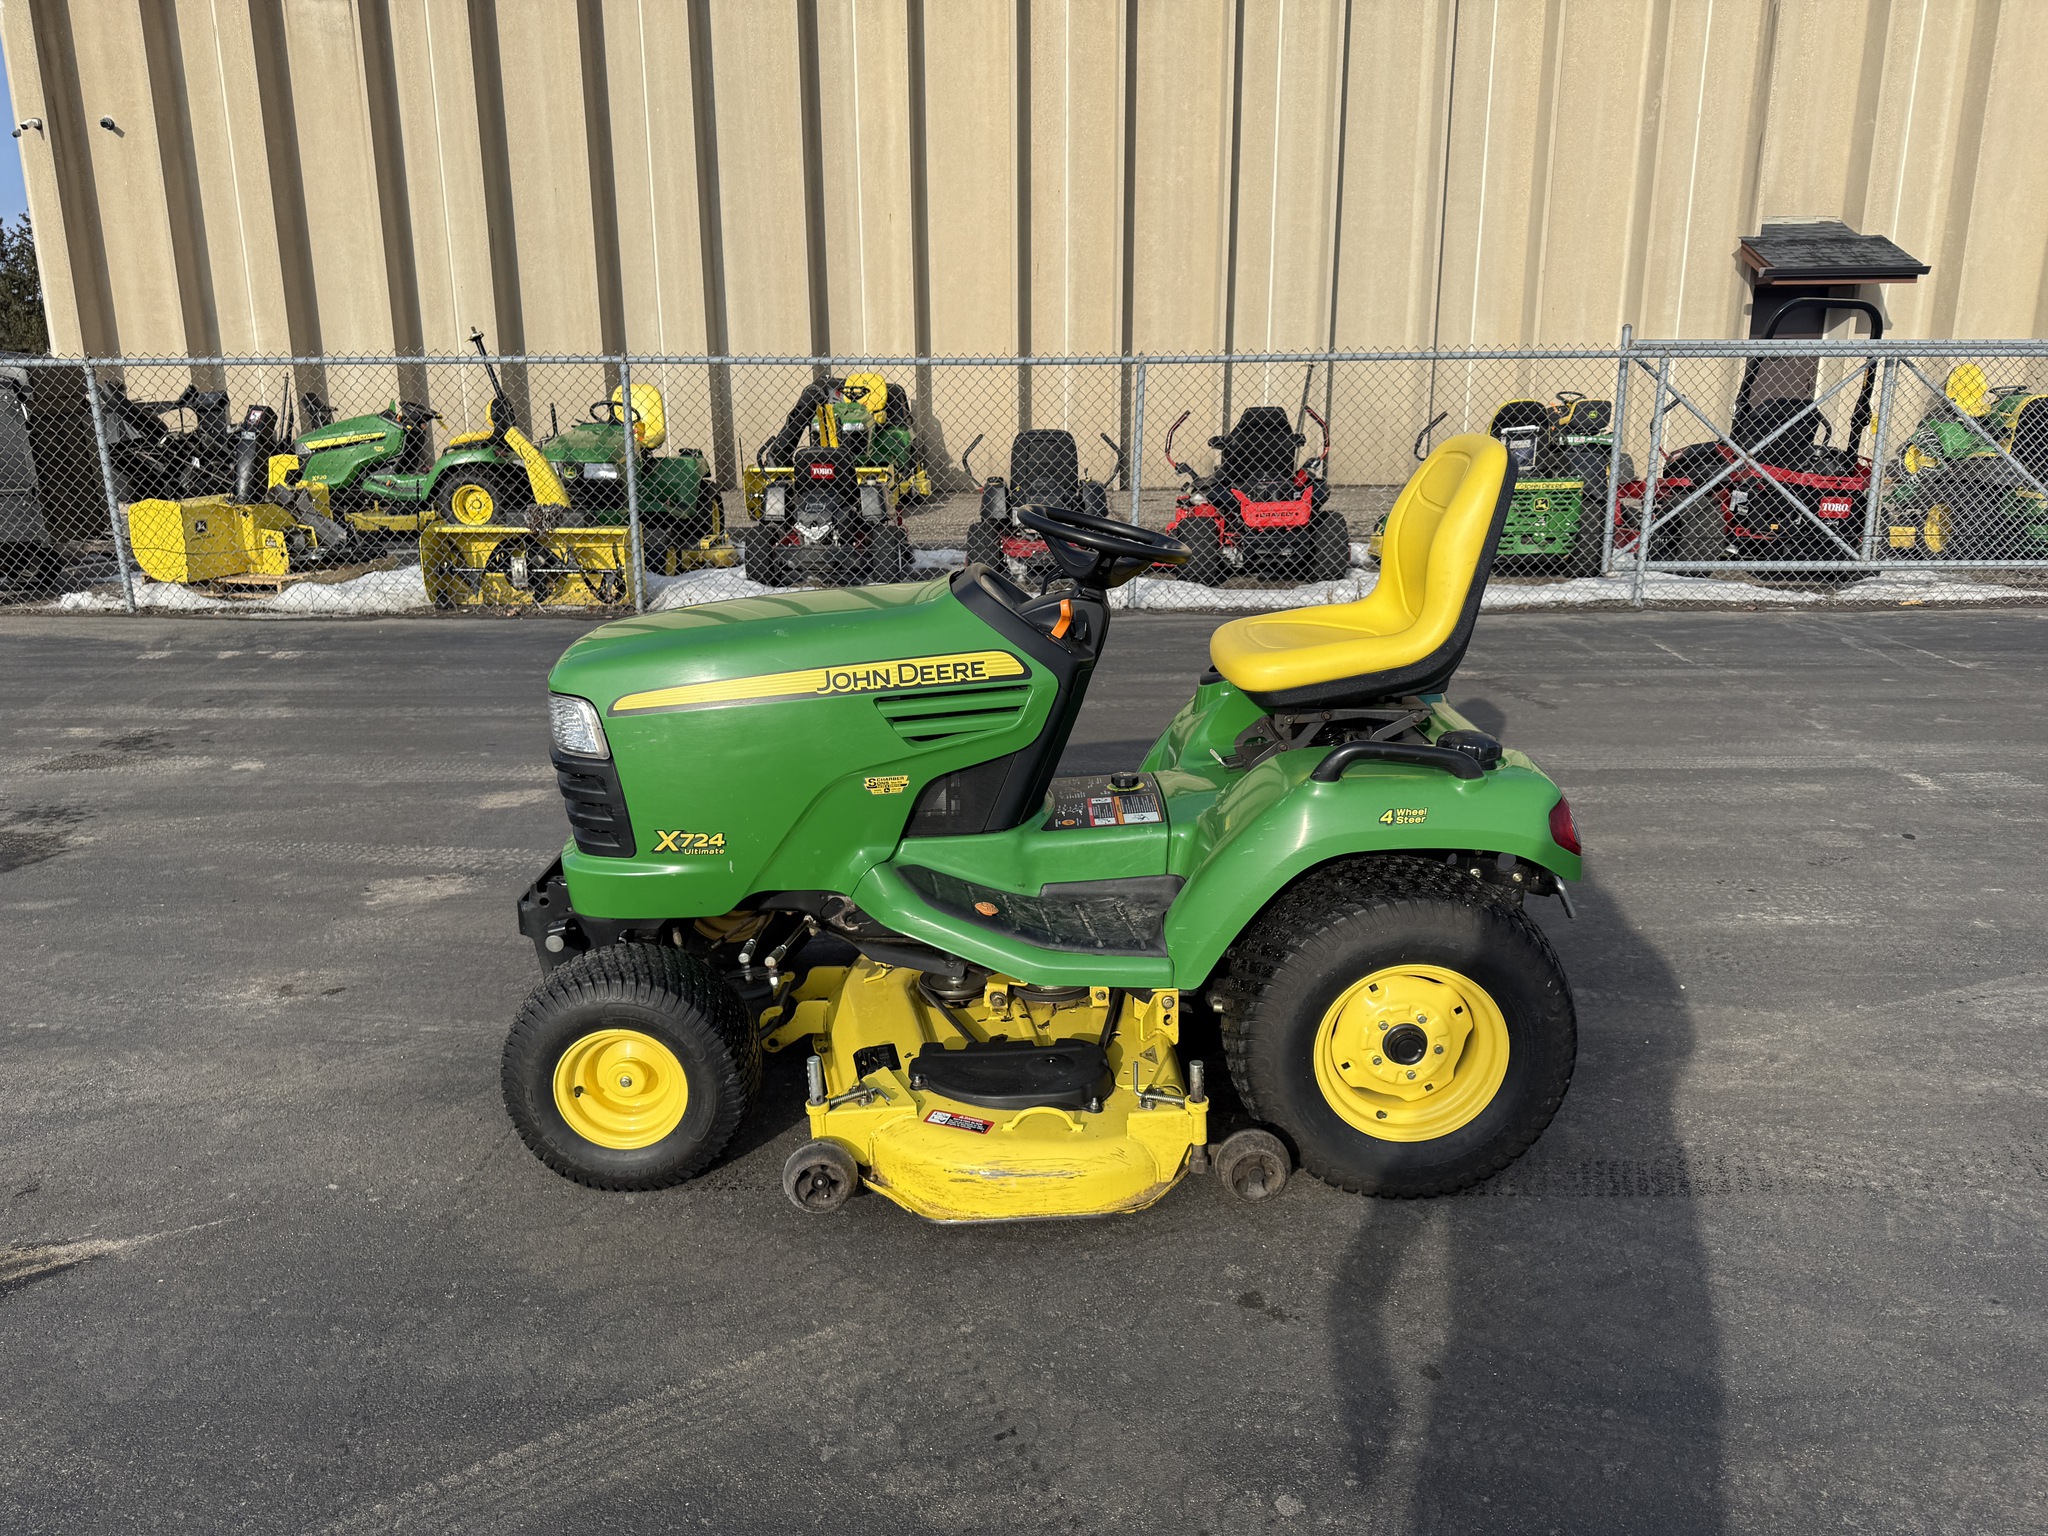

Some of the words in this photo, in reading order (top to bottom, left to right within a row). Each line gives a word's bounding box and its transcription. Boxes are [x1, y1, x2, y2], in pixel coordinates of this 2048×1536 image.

[812, 467, 833, 475] TORO
[1822, 502, 1849, 512] TORO
[817, 668, 890, 692] JOHN
[898, 661, 987, 683] DEERE
[1379, 809, 1394, 824] 4
[1396, 807, 1427, 816] Wheel
[1396, 816, 1426, 824] Steer
[654, 830, 726, 852] X724
